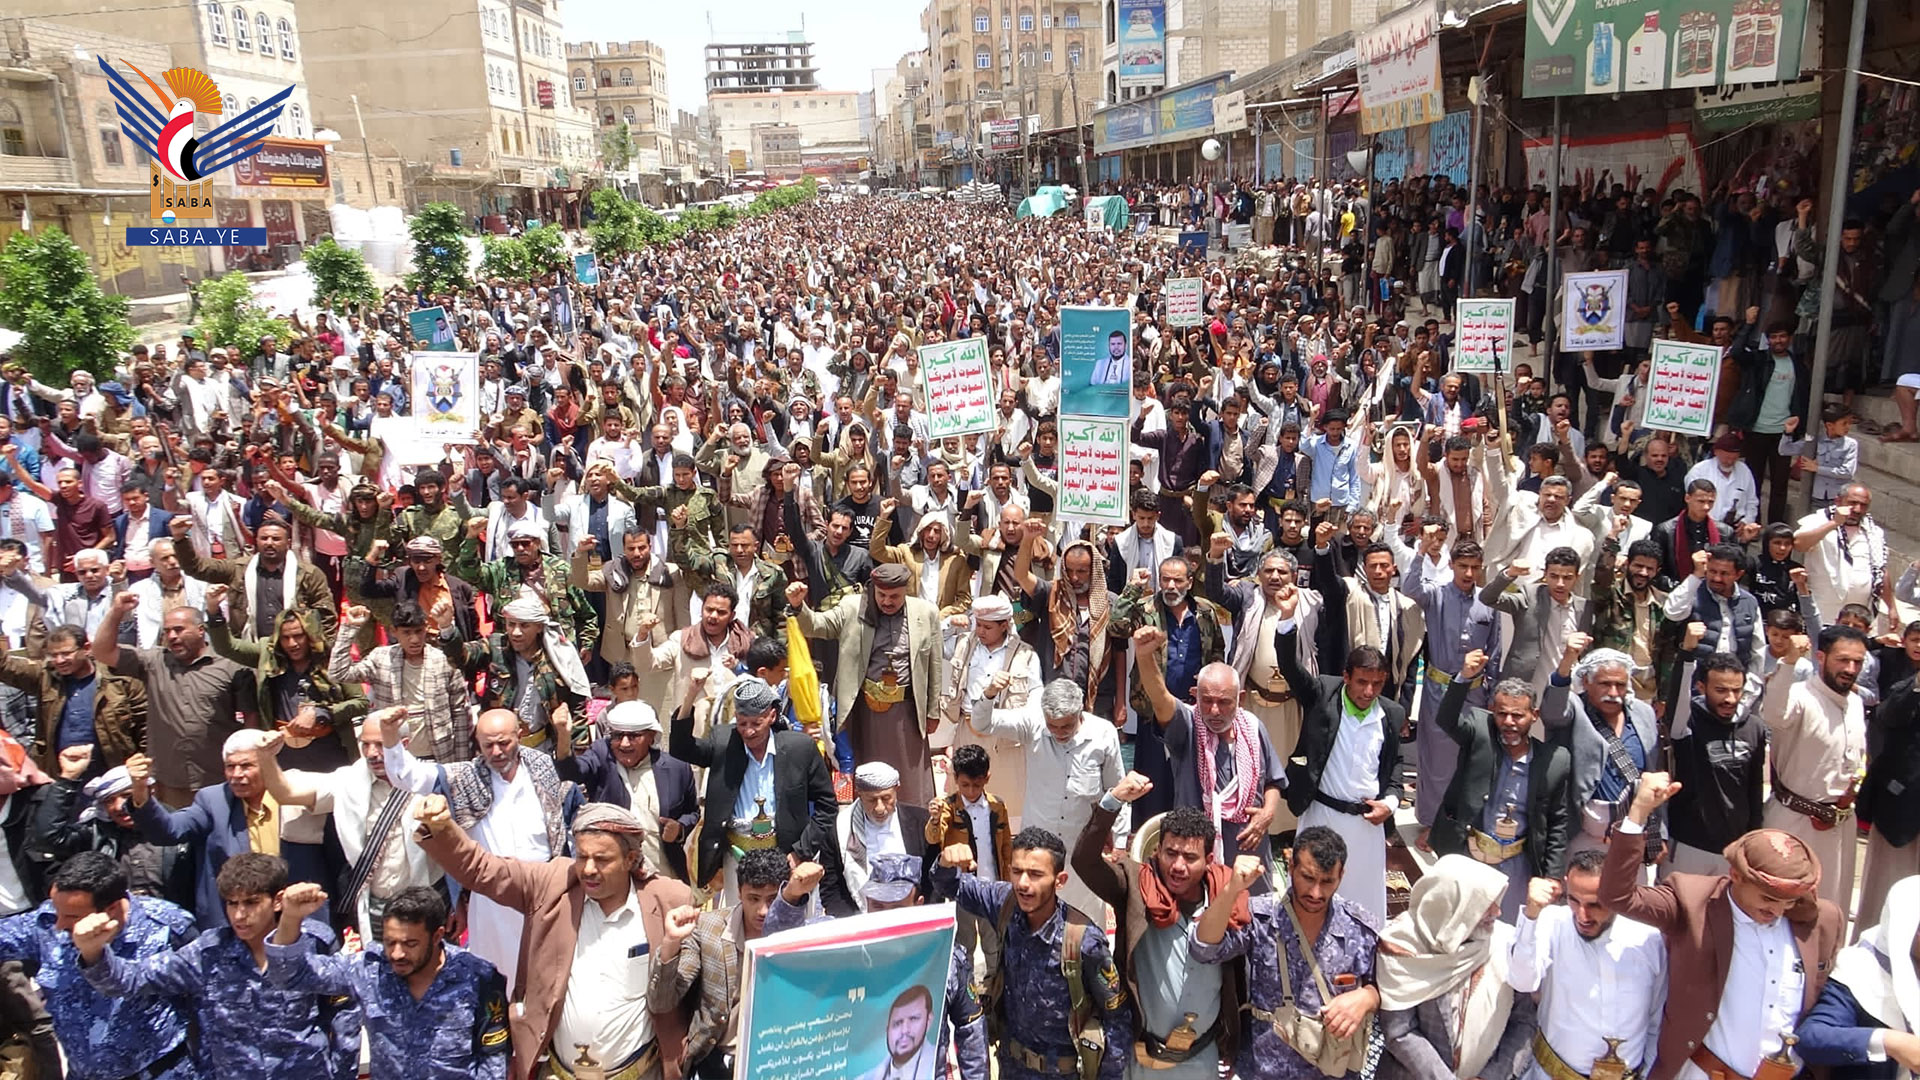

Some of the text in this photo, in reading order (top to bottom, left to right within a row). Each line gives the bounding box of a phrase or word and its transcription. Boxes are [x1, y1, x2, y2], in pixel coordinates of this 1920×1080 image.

[1492, 306, 1508, 316] الله
[960, 344, 981, 361] الله
[1692, 353, 1713, 366] الله
[959, 365, 984, 378] الموت
[1687, 372, 1711, 381] الموت
[961, 380, 986, 393] الموت
[1685, 387, 1709, 395] الموت
[932, 396, 988, 414] اللعنة على اليهود
[1653, 396, 1706, 409] اللعنة على اليهود
[965, 409, 990, 428] النصر
[1679, 411, 1705, 424] النصر
[1065, 424, 1120, 444] الله أكبر
[1095, 449, 1120, 460] الموت
[1095, 466, 1120, 476] الموت
[1064, 479, 1120, 491] اللعنة على اليهود
[1093, 495, 1119, 512] النصر
[834, 1010, 852, 1021] نحن
